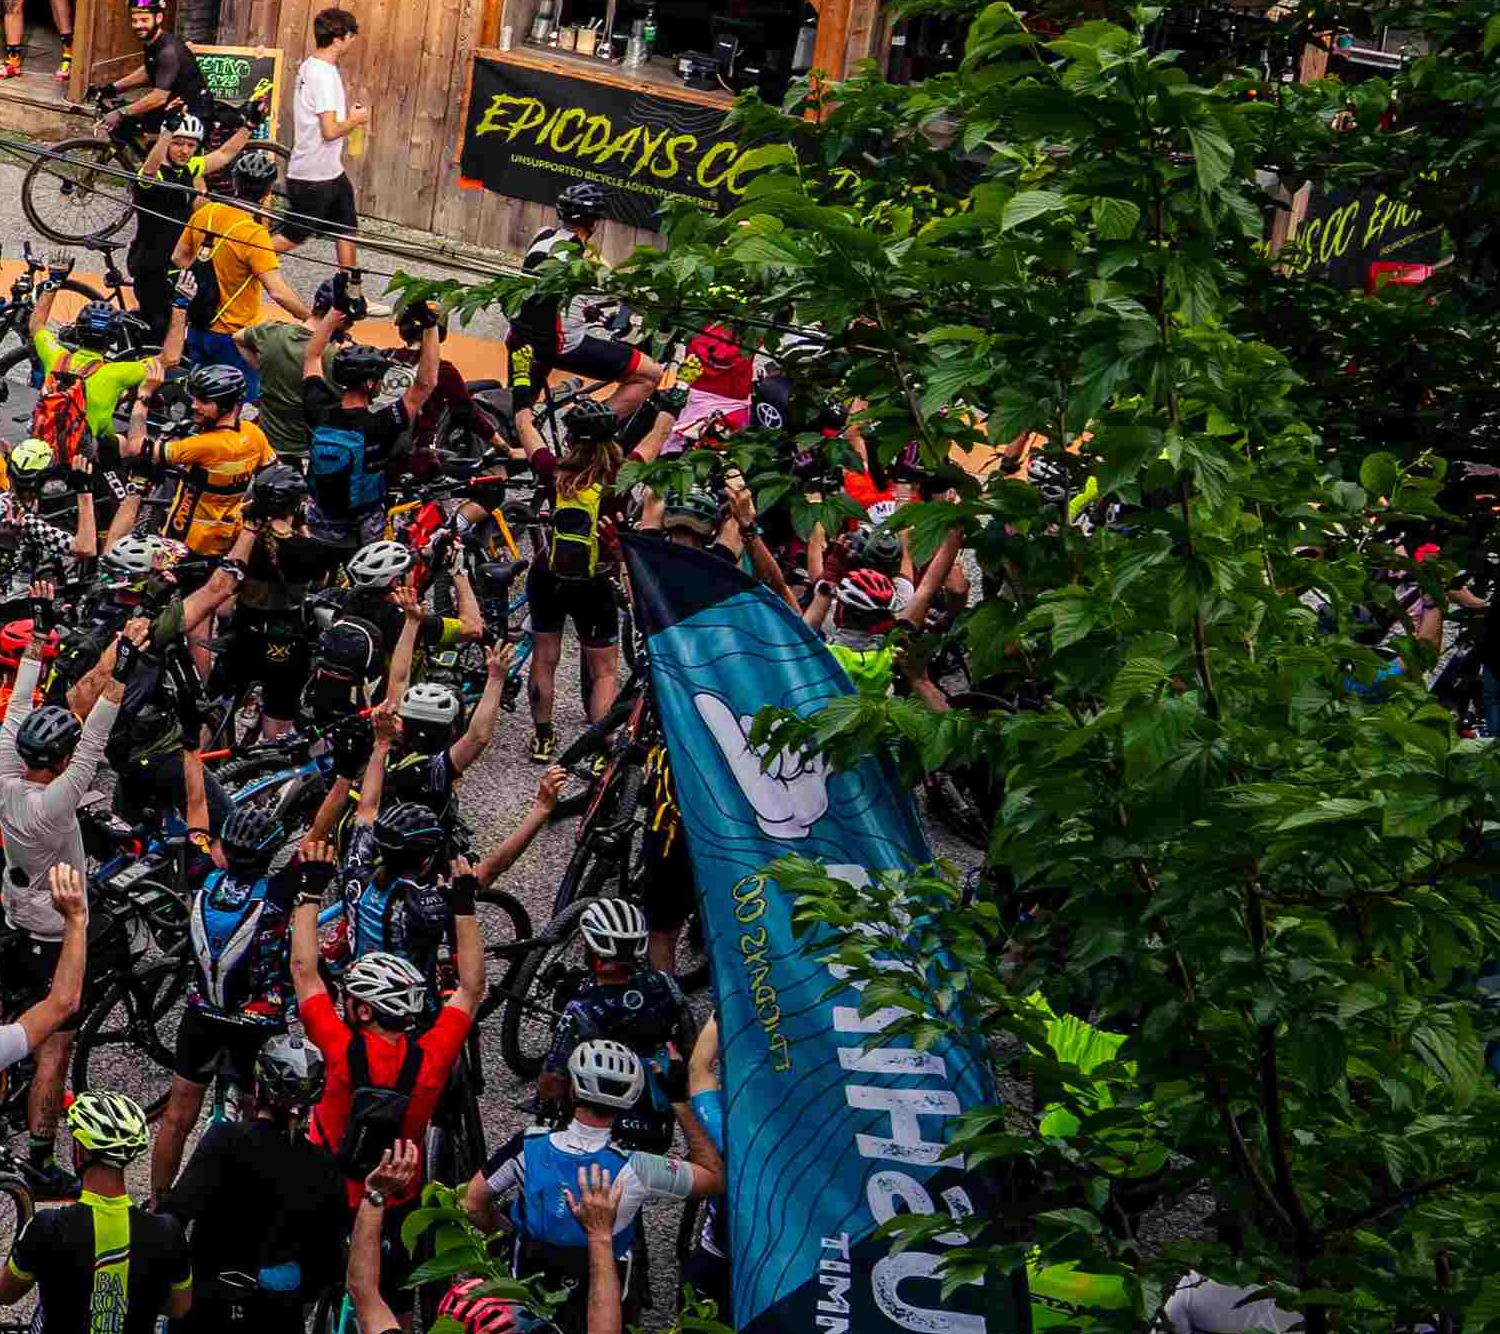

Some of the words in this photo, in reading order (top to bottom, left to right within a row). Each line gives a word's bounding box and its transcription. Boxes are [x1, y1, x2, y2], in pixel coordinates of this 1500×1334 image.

[476, 93, 754, 195] EPICDAYS.CC
[510, 153, 584, 180] UNSUPPORTED
[584, 170, 625, 188] BICYCLE
